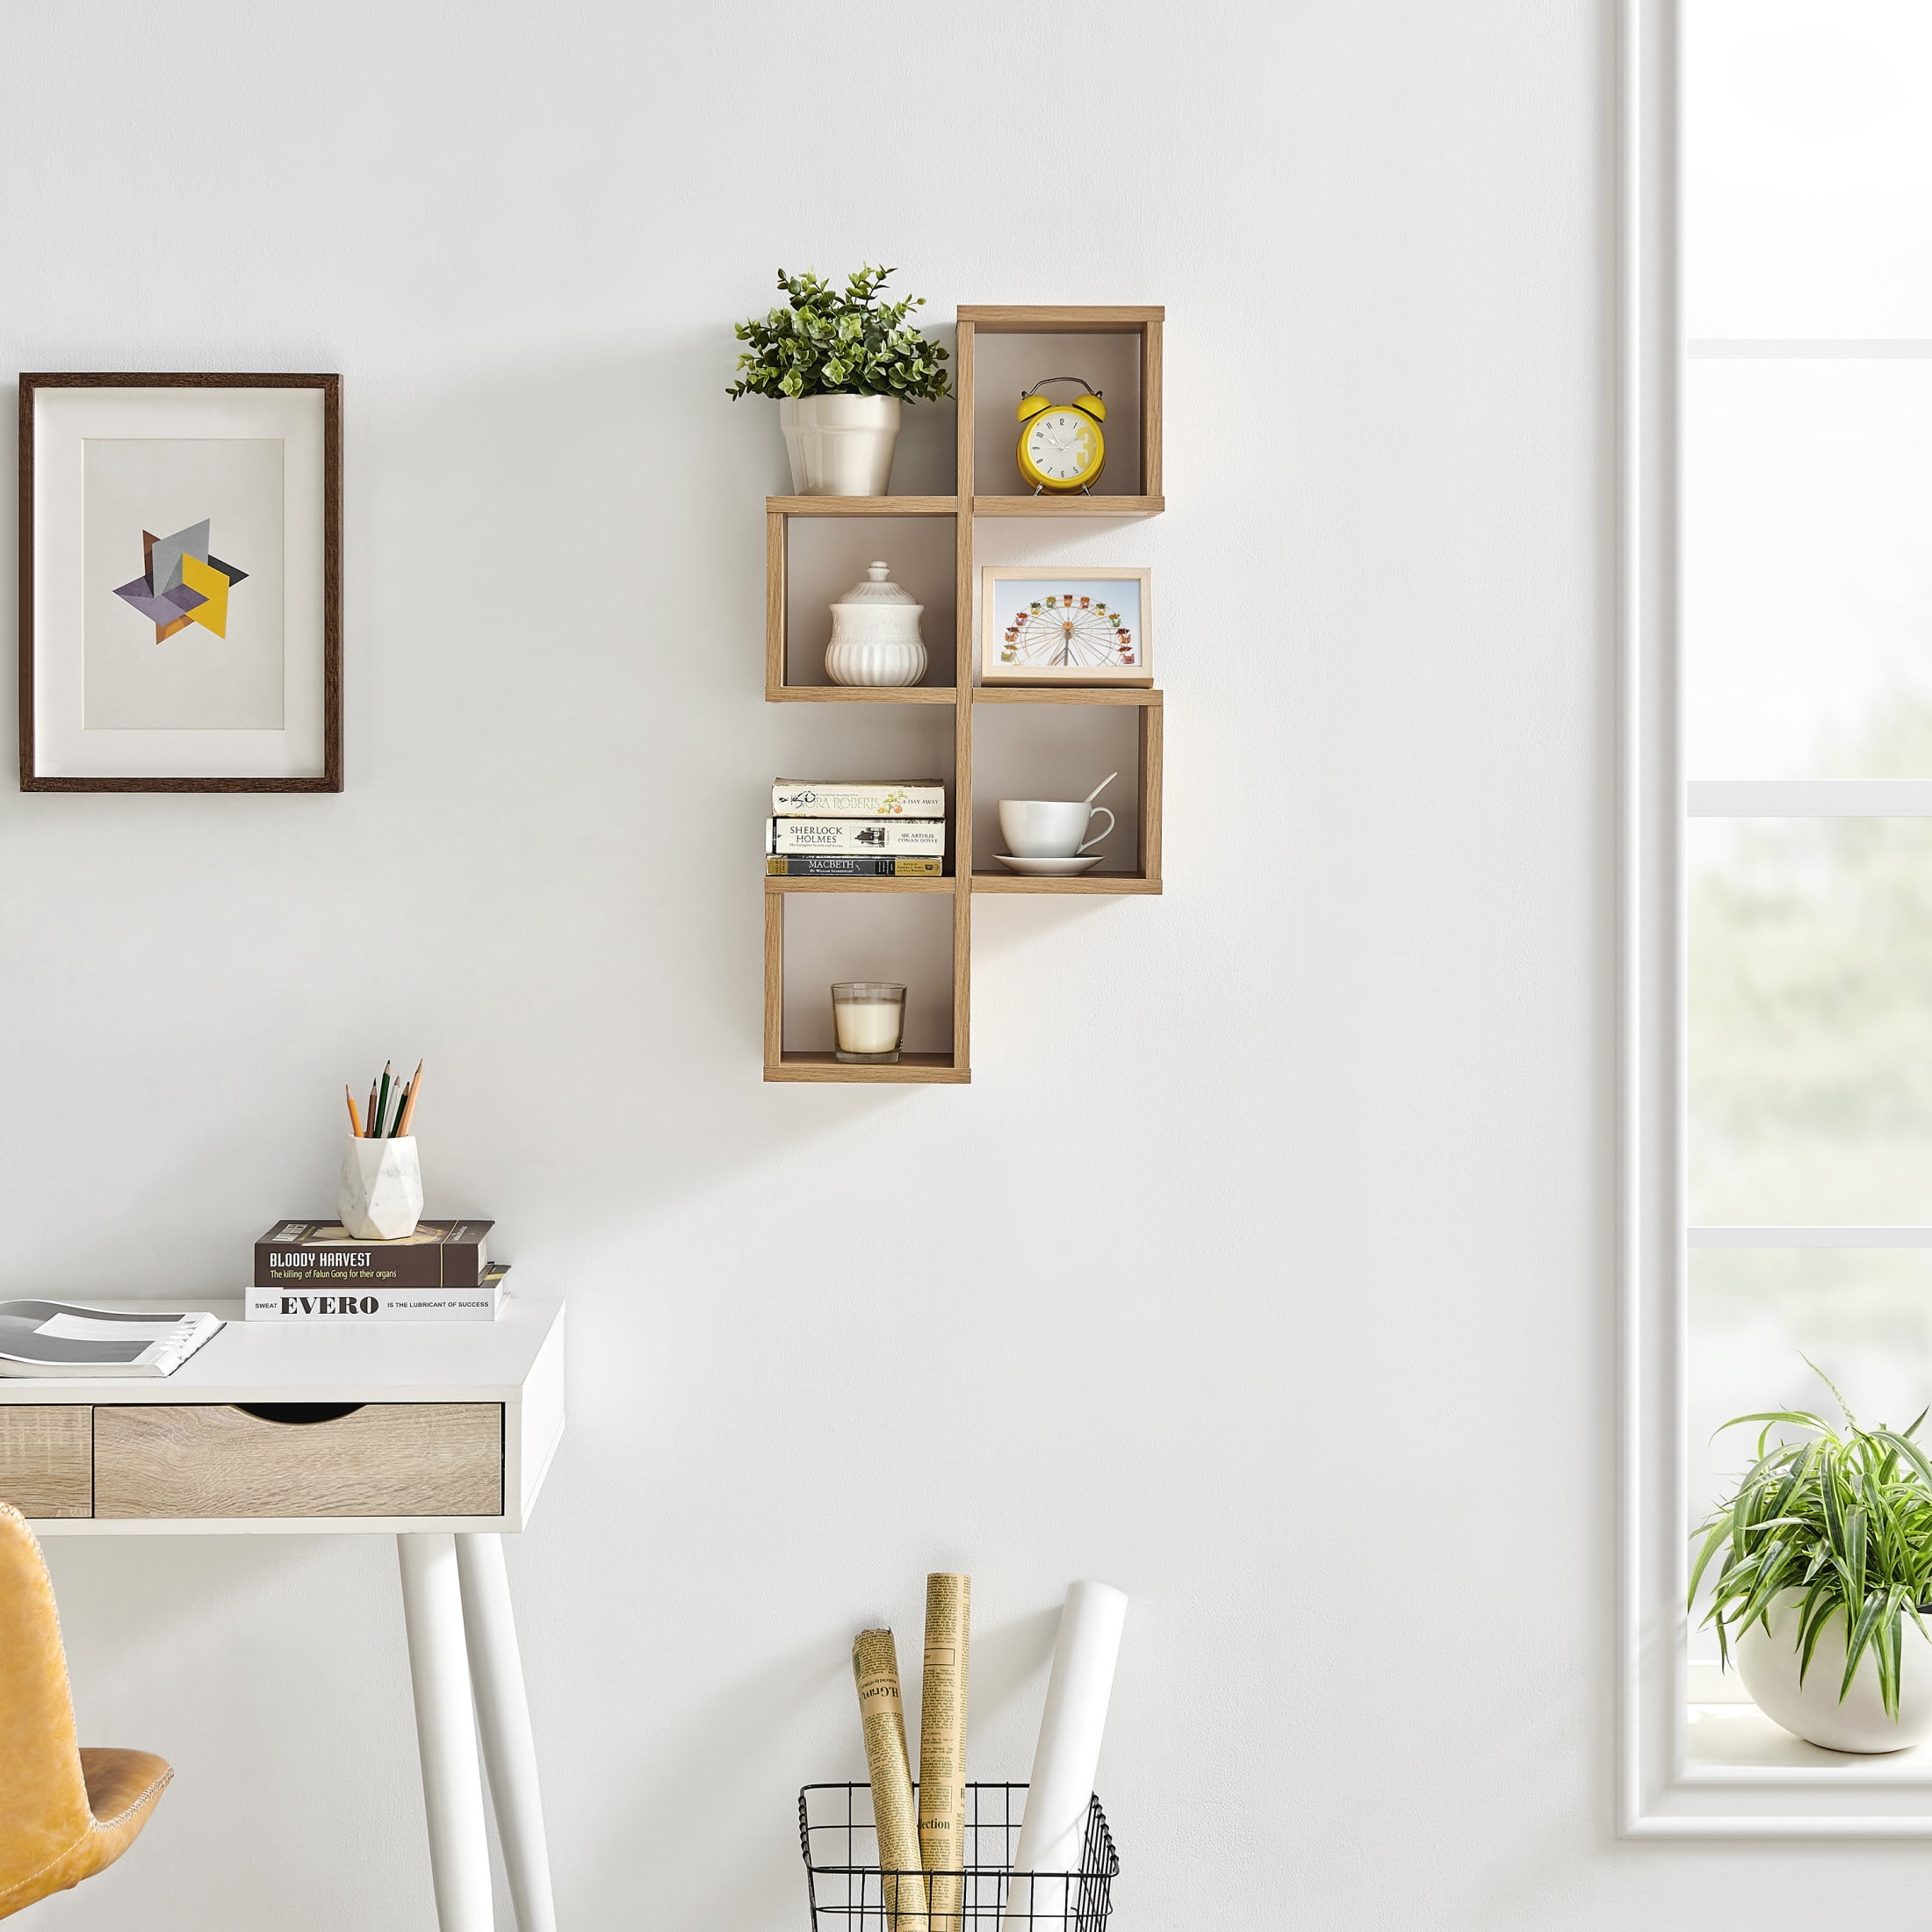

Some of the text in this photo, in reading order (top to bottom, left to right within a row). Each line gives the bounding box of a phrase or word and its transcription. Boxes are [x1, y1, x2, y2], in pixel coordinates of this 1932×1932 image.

[833, 797, 880, 810] ROBERTS
[789, 826, 843, 835] SHERLOCK
[809, 860, 854, 869] MACBETH
[270, 1252, 371, 1267] BLOODY HARVEST
[270, 1269, 397, 1280] The killing of Falun Gong for their organs
[279, 1296, 379, 1315] EVERO
